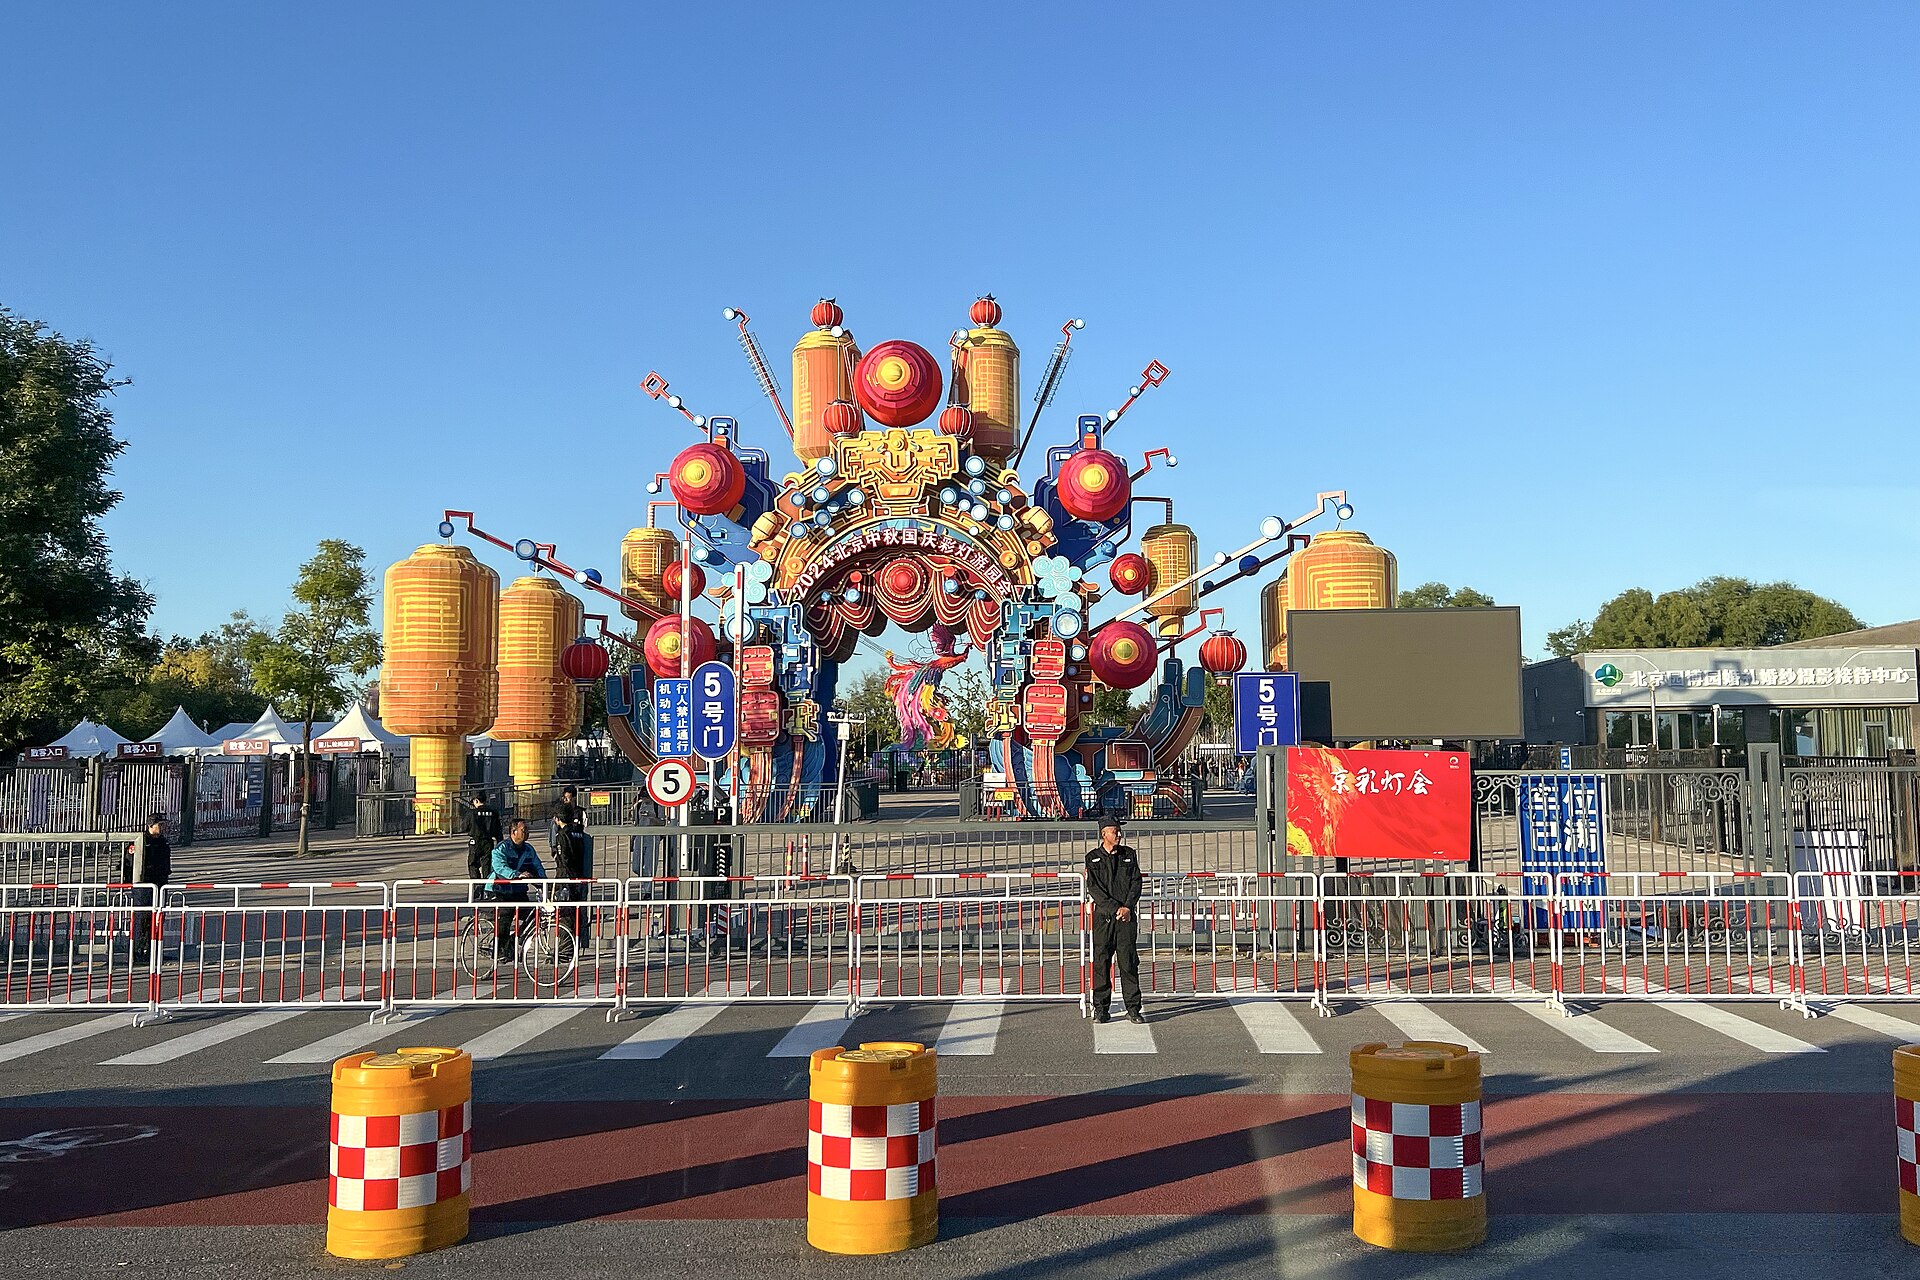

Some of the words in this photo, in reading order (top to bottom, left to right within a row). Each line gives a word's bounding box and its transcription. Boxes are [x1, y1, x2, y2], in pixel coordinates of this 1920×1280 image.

[791, 527, 1014, 600] 2024北京中秋国庆彩灯游园会
[658, 683, 672, 753] 机动车通道
[676, 683, 688, 752] 行人禁止通行
[702, 671, 725, 748] 5号门
[1256, 678, 1278, 746] 5号门
[229, 741, 264, 750] 散客入口
[662, 769, 680, 795] 5
[717, 807, 726, 821] P
[1330, 766, 1433, 796] 京彩灯会
